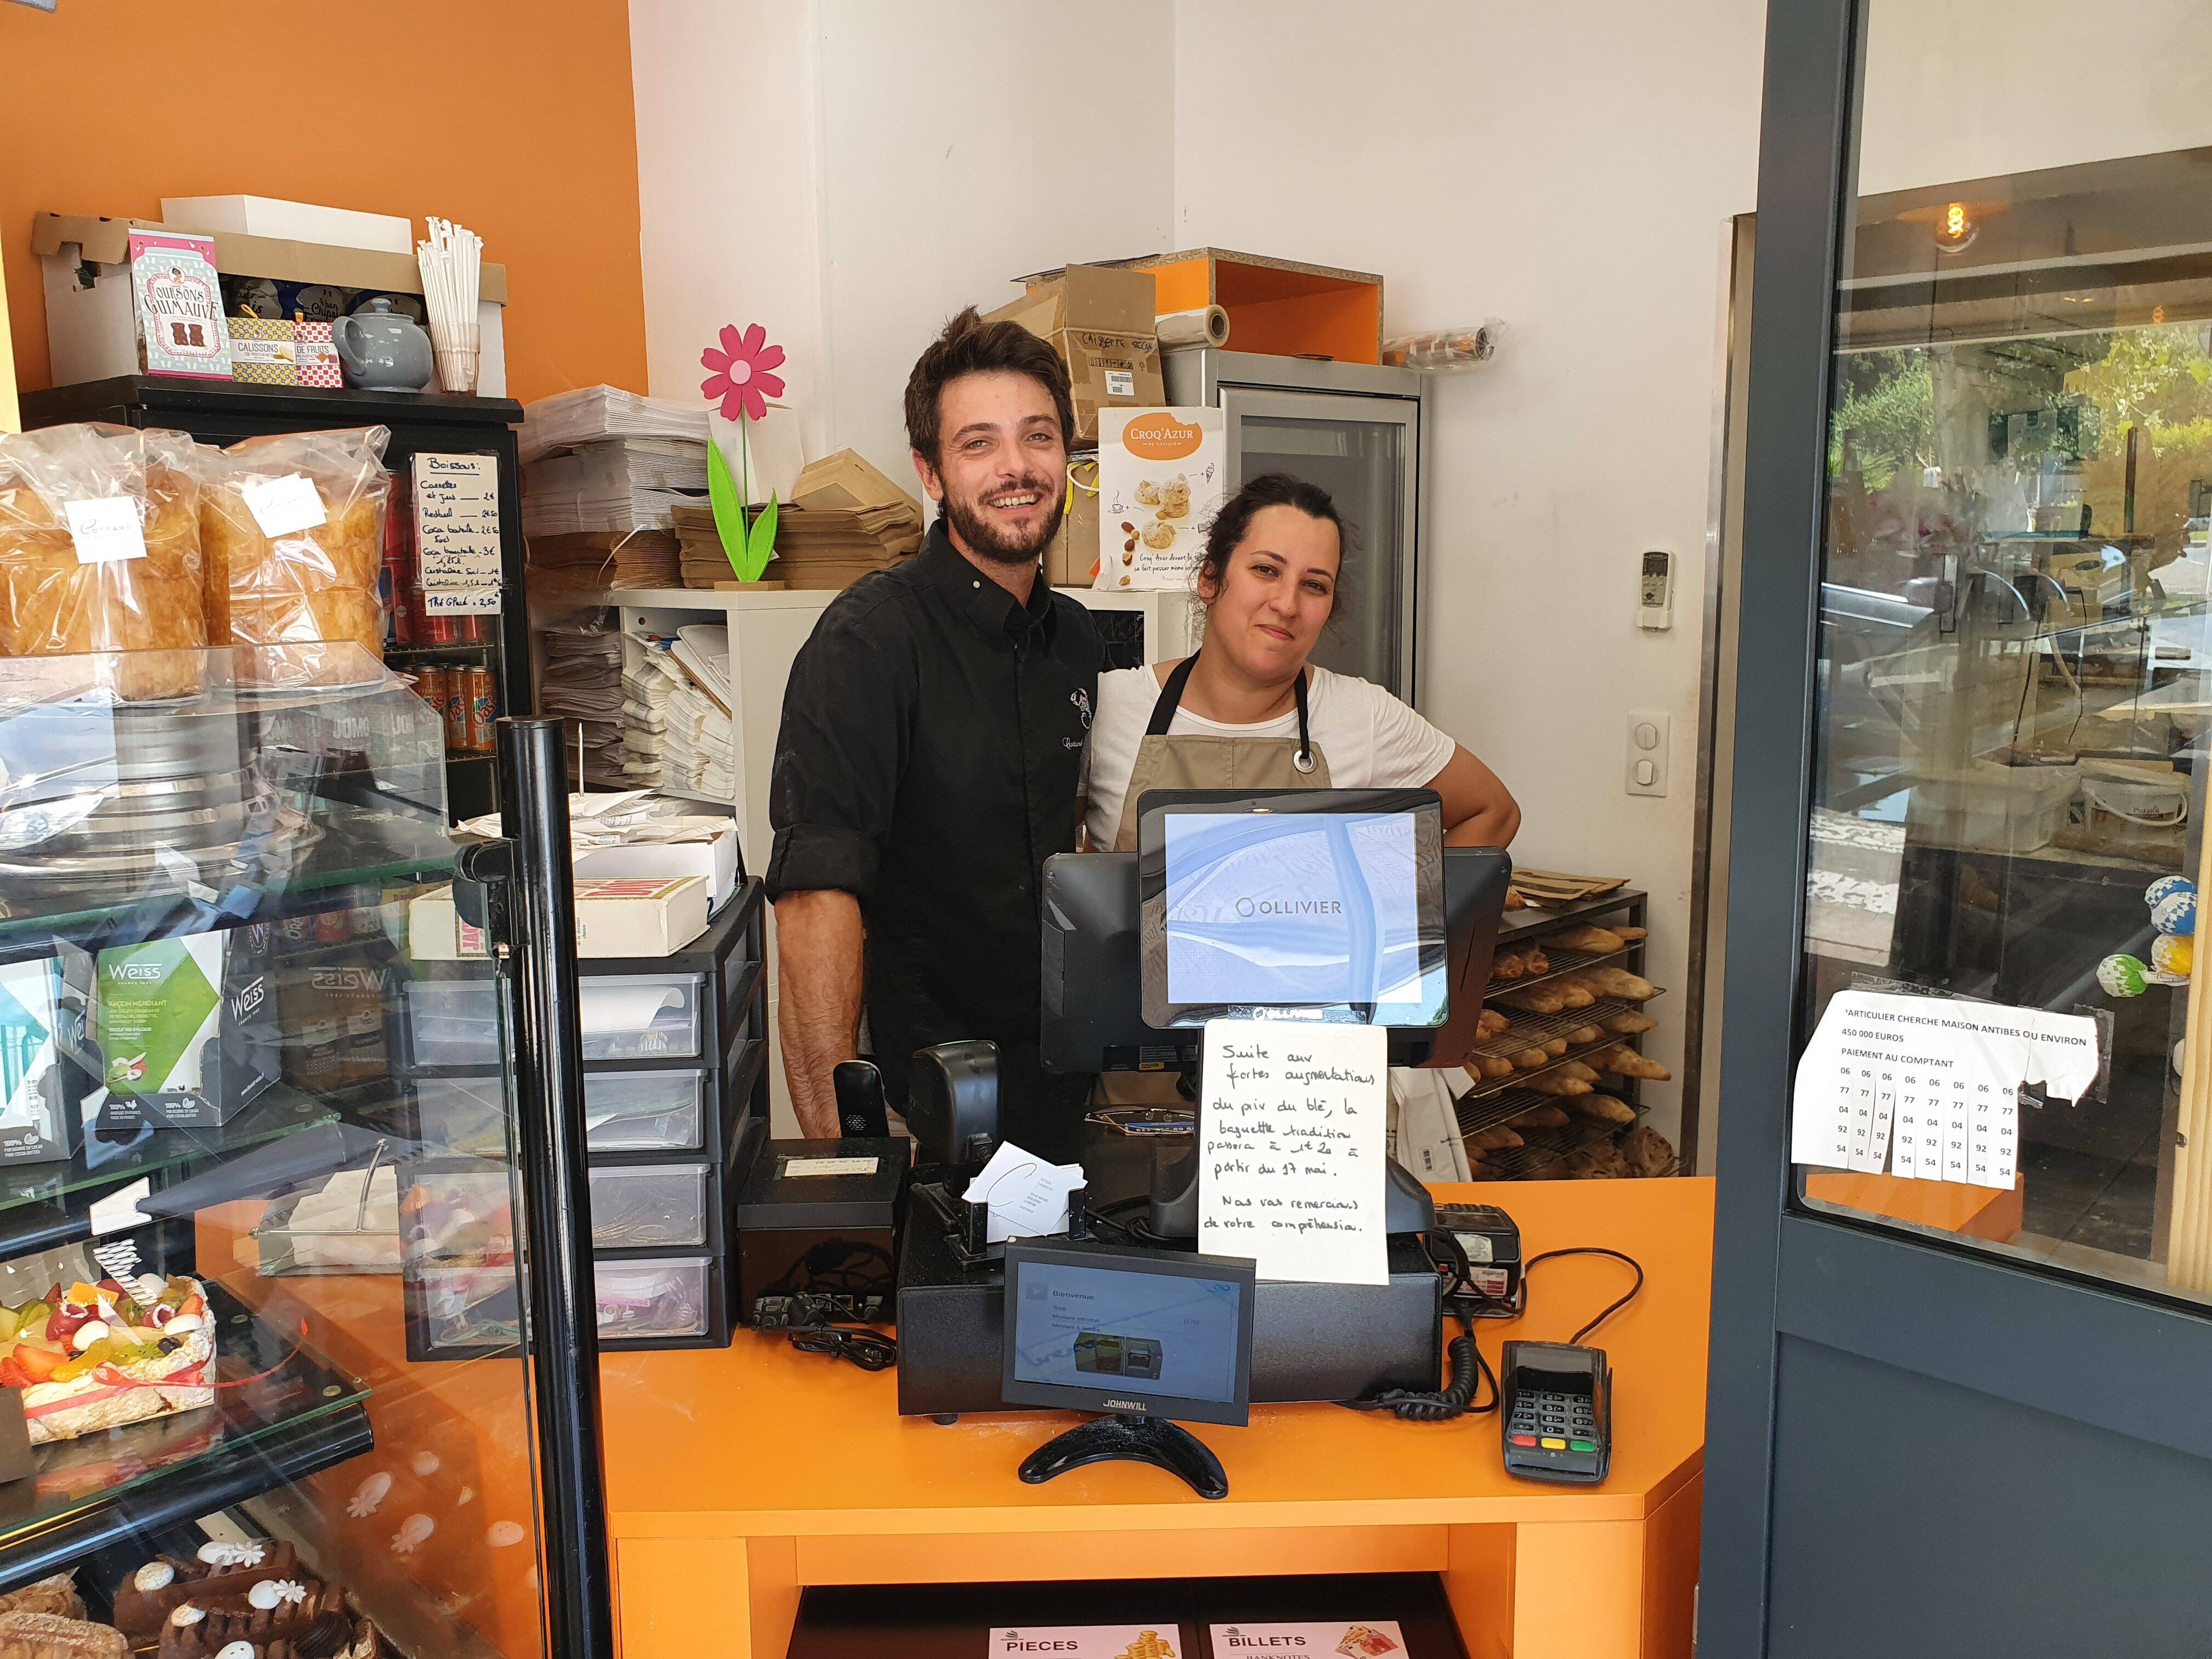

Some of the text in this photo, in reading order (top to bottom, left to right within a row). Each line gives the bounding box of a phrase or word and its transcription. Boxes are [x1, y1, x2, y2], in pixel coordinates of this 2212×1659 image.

[156, 287, 204, 302] OURSONS
[144, 295, 218, 321] GUIMAUVE
[238, 342, 279, 353] CALISSONS
[307, 346, 329, 354] FRUITS
[1130, 427, 1193, 441] CROQ'AZUR
[439, 493, 456, 504] Jus
[422, 524, 444, 534] Coca
[428, 597, 443, 608] Thé
[1259, 901, 1342, 915] OLLIVIER
[109, 963, 162, 980] Weiss
[231, 976, 264, 1022] Weiss
[1859, 1030, 1874, 1039] 000
[1875, 1032, 1904, 1042] EUROS
[1897, 1015, 1939, 1026] CHERCHE
[1942, 1019, 1979, 1031] MAISON
[1981, 1025, 2021, 1037] ANTIBES
[2023, 1030, 2038, 1040] OU
[2041, 1034, 2087, 1046] ENVIRON
[1222, 1044, 1269, 1059] Suite
[1841, 1048, 1955, 1068] PAIEMENT AU COMPTANT
[1227, 1063, 1269, 1089] fortes
[1978, 1085, 1989, 1093] 06
[1213, 1097, 1233, 1110] du
[1277, 1100, 1297, 1111] du
[1345, 1098, 1357, 1114] la
[1977, 1125, 1988, 1133] 04
[1838, 1125, 1847, 1133] 92
[1858, 1129, 1866, 1137] 92
[1876, 1132, 1886, 1141] 92
[1976, 1144, 1987, 1153] 92
[2000, 1148, 2011, 1156] 92
[1207, 1141, 1255, 1155] passera
[1215, 1159, 1250, 1180] partir
[1259, 1164, 1276, 1175] du
[1283, 1163, 1296, 1175] 17
[1901, 1156, 1912, 1164] 54
[1976, 1164, 1986, 1172] 54
[2000, 1168, 2011, 1176] 54
[1204, 1216, 1255, 1228] de votre
[1053, 1290, 1094, 1300] Bienvenue
[1103, 1399, 1147, 1411] JOHNWILL
[1007, 1640, 1078, 1651] PIECES
[1229, 1636, 1306, 1646] BILLETS
